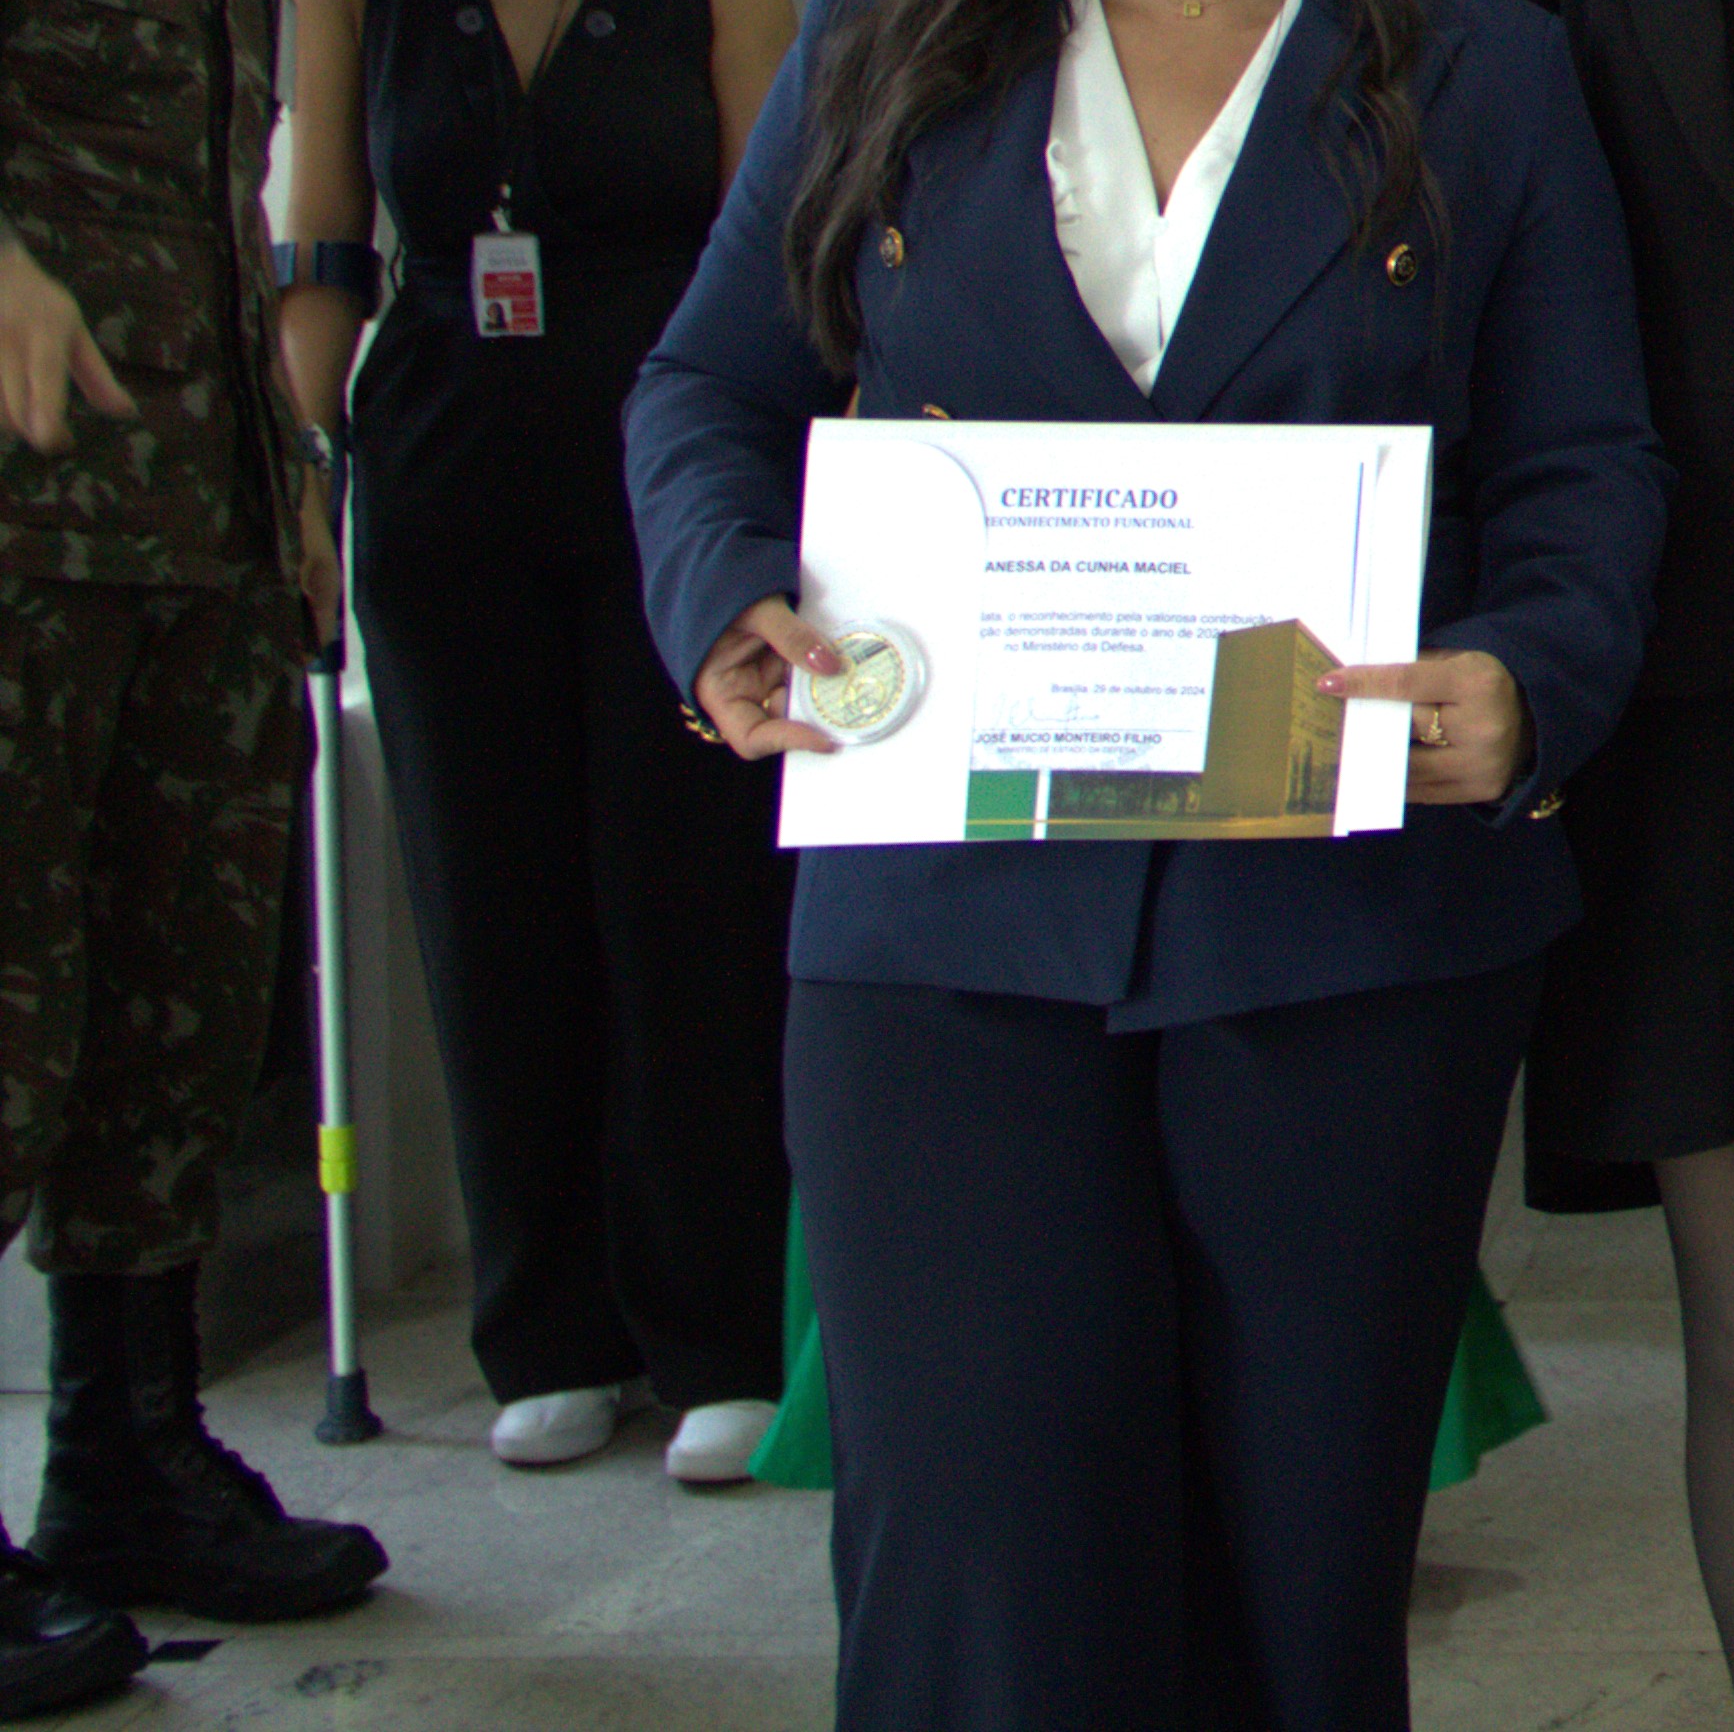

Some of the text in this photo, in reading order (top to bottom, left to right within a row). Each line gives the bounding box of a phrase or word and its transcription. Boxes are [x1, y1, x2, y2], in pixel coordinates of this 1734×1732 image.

[1001, 487, 1178, 509] CERTIFICADO
[1114, 517, 1195, 530] FUNCIONAL
[985, 560, 1192, 575] ANESSA DA CUNHA MACIEL
[975, 731, 1162, 744] JOSÉ MUCIO MONTEIRO FILHO
